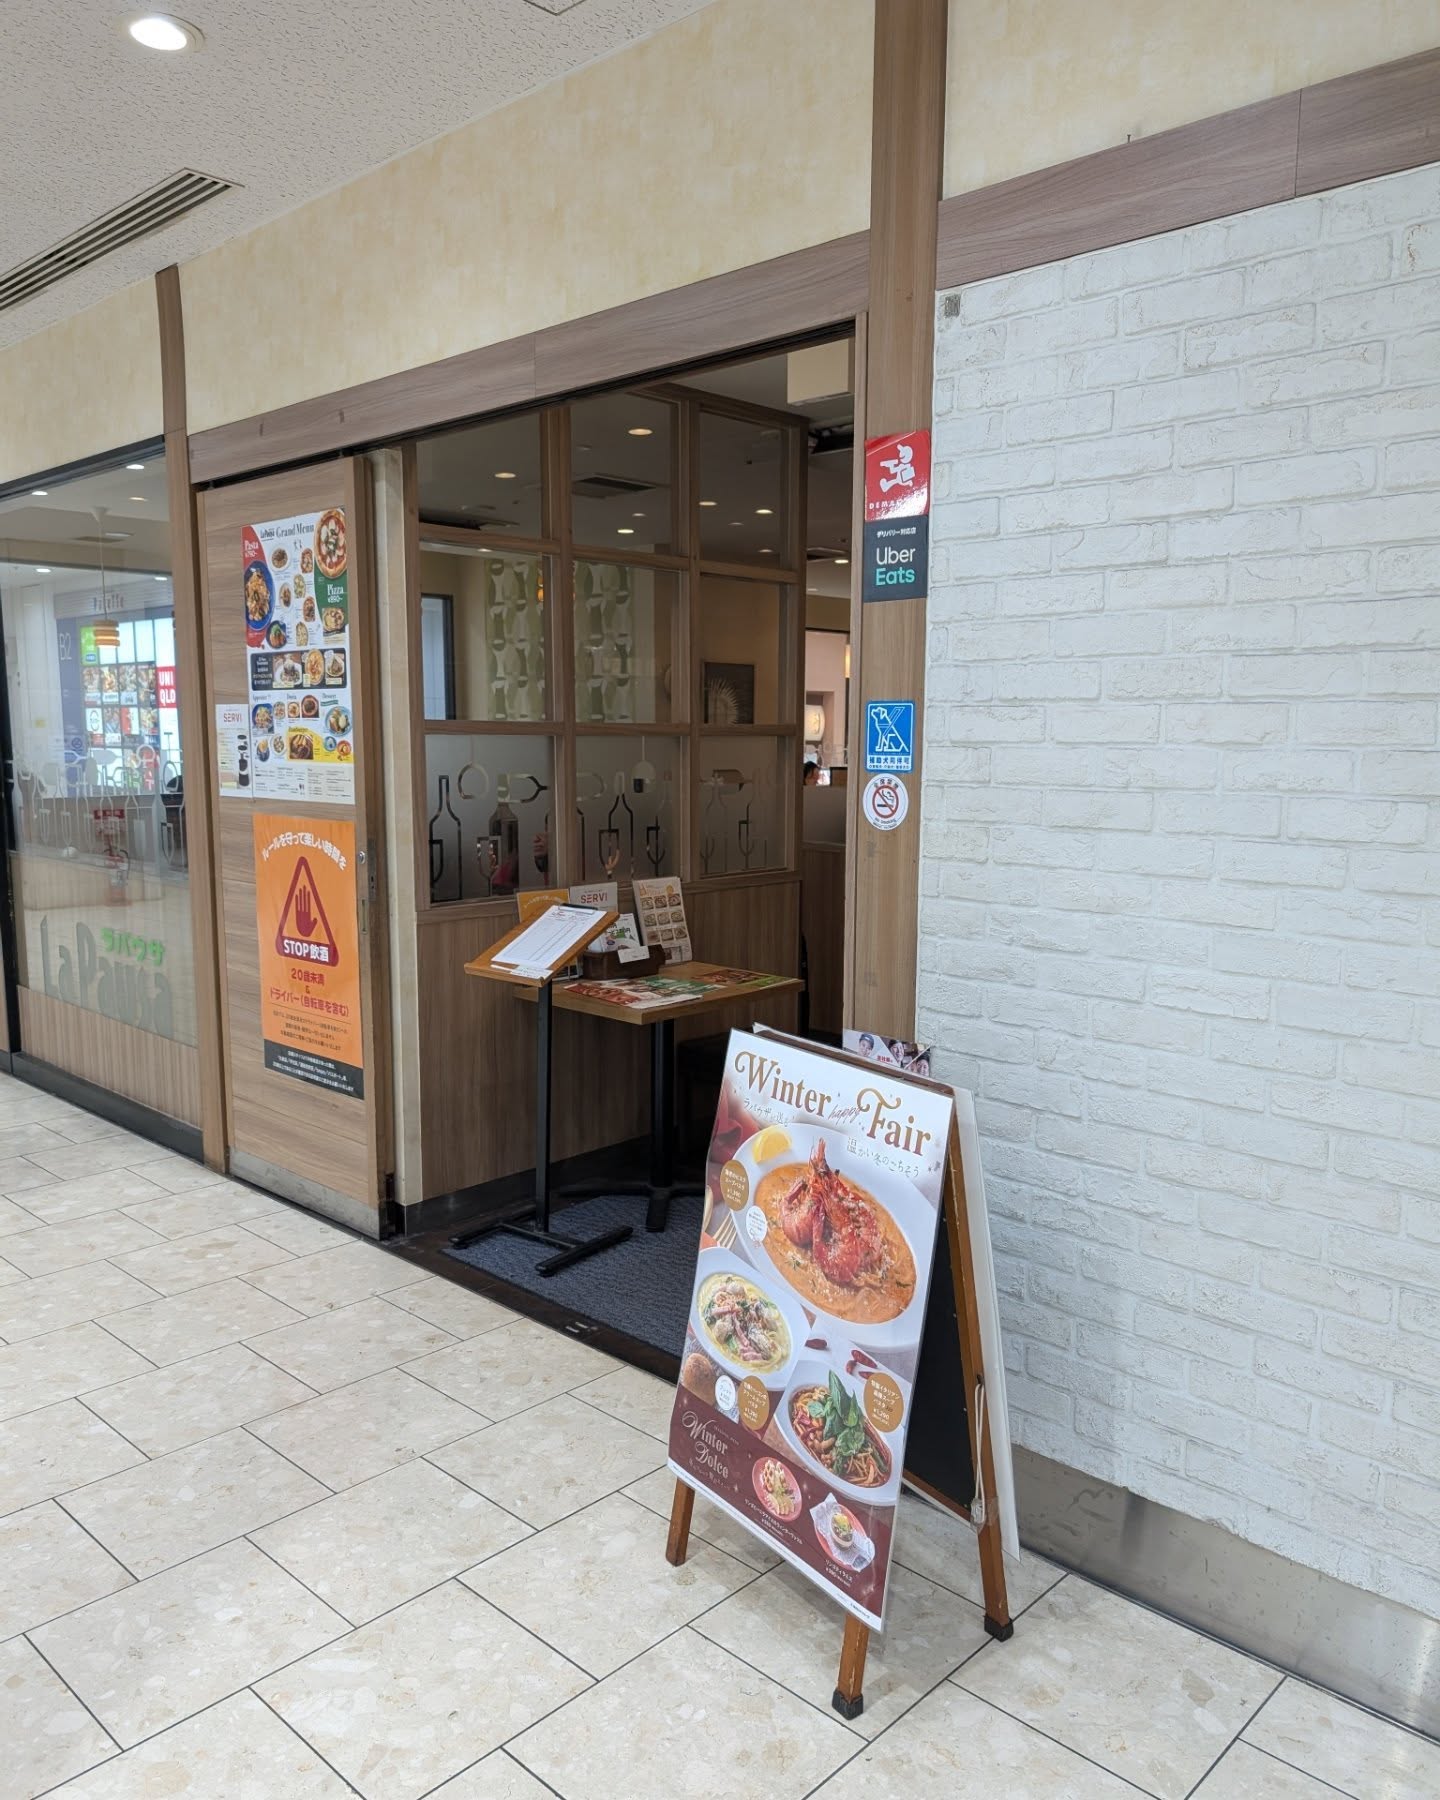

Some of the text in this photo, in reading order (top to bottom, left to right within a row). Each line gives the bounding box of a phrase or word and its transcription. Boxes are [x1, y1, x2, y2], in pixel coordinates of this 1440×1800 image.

[276, 524, 296, 538] Grand
[297, 523, 315, 535] Menu
[244, 540, 259, 551] Pasta
[876, 546, 916, 565] Uber
[875, 566, 915, 586] Eats
[327, 584, 344, 596] Pizza
[59, 632, 73, 661] B2
[158, 670, 174, 687] UNI
[160, 688, 176, 706] QLO
[223, 713, 242, 723] SERVI
[580, 893, 608, 905] SERVI
[283, 939, 329, 963] STOP 飲酒
[290, 967, 325, 987] 20歳未満
[734, 1050, 931, 1156] Winter happy Fair
[681, 1410, 728, 1455] Winter
[695, 1441, 729, 1479] Dolce
